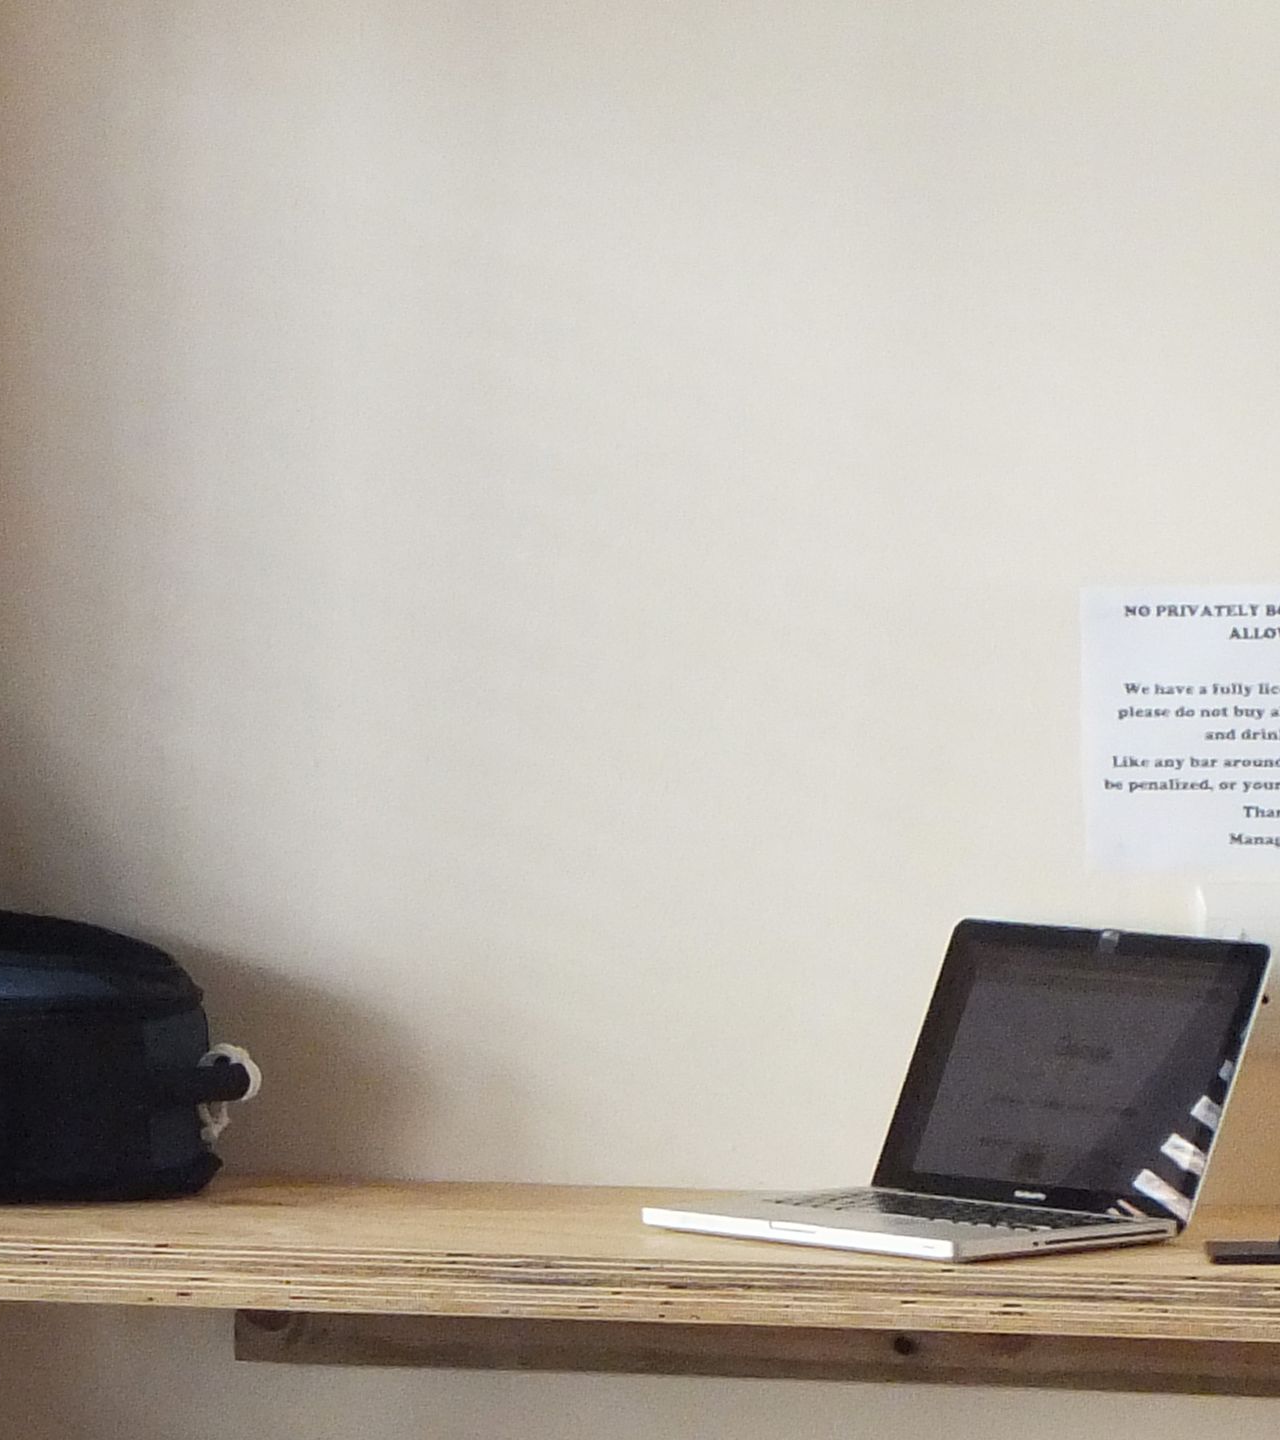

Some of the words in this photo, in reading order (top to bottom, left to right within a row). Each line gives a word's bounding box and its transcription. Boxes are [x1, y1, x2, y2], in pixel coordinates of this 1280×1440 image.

[1123, 604, 1152, 618] NO
[1155, 603, 1260, 618] PRIVATELY
[1123, 682, 1151, 696] We
[1153, 683, 1195, 696] have
[1198, 685, 1208, 696] a
[1211, 682, 1253, 698] fully
[1117, 705, 1172, 721] please
[1174, 705, 1196, 718] do
[1199, 706, 1229, 718] not
[1232, 704, 1266, 721] buy
[1204, 728, 1237, 741] and
[1112, 755, 1150, 769] Like
[1153, 758, 1185, 771] any
[1189, 755, 1219, 769] bar
[1103, 778, 1124, 791] be
[1218, 780, 1238, 791] or
